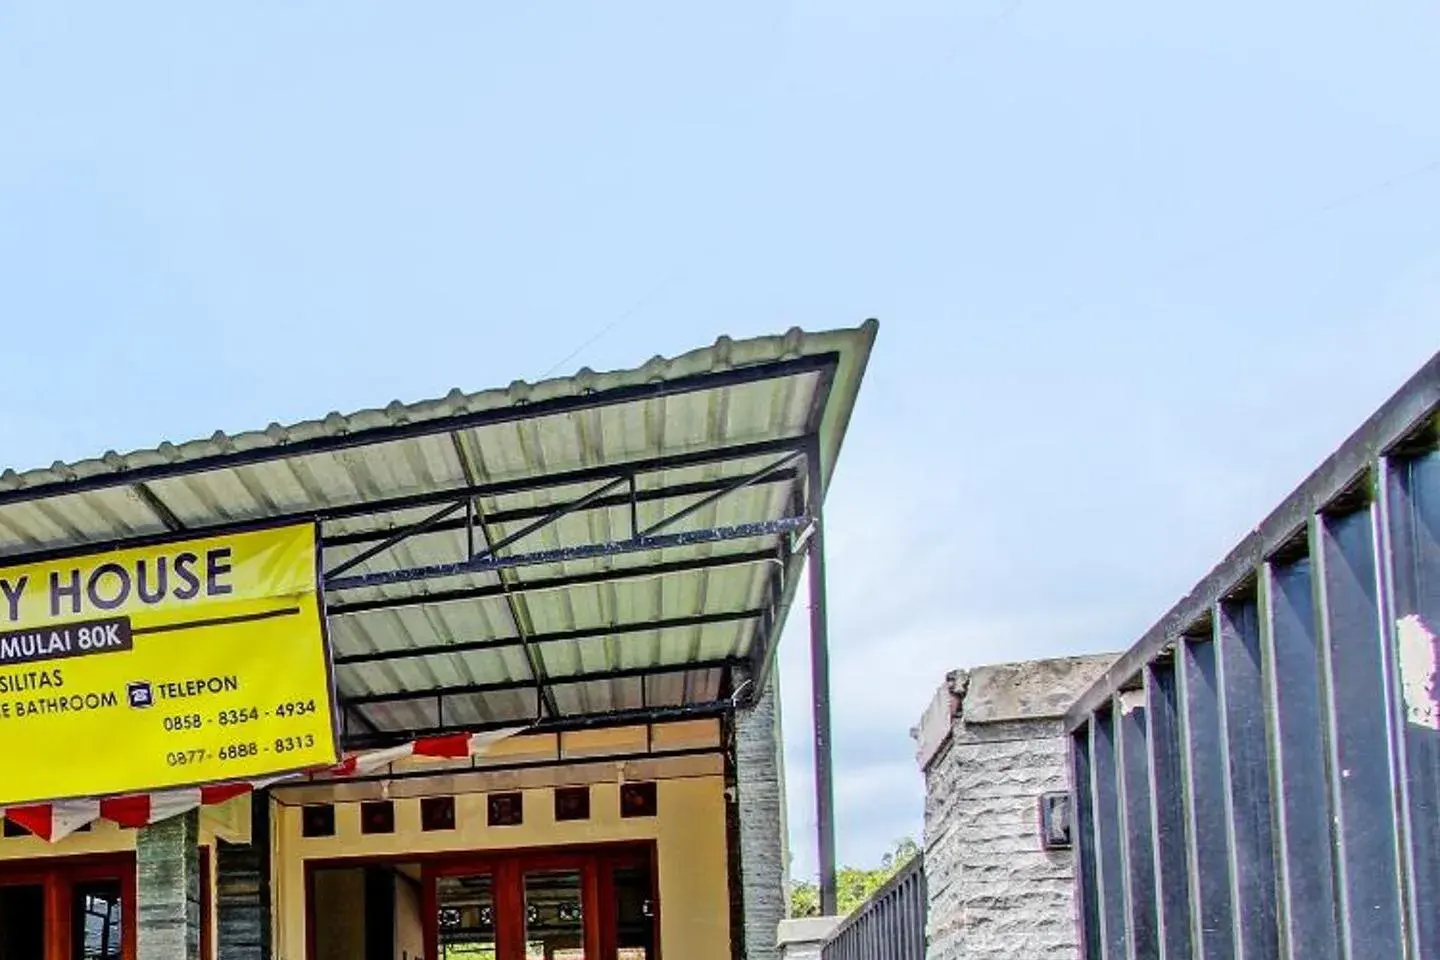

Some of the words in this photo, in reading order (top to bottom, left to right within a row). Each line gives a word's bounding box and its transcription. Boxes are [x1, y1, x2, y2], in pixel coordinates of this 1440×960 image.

[49, 548, 232, 616] HOUSE
[0, 630, 71, 658] MULAI
[78, 623, 121, 650] 80K
[158, 675, 238, 699] TELEPON
[16, 691, 118, 717] BATHROOM
[163, 714, 202, 731] 0858
[275, 699, 316, 718] 4934
[218, 742, 258, 760] 6888
[274, 735, 314, 753] 8313
